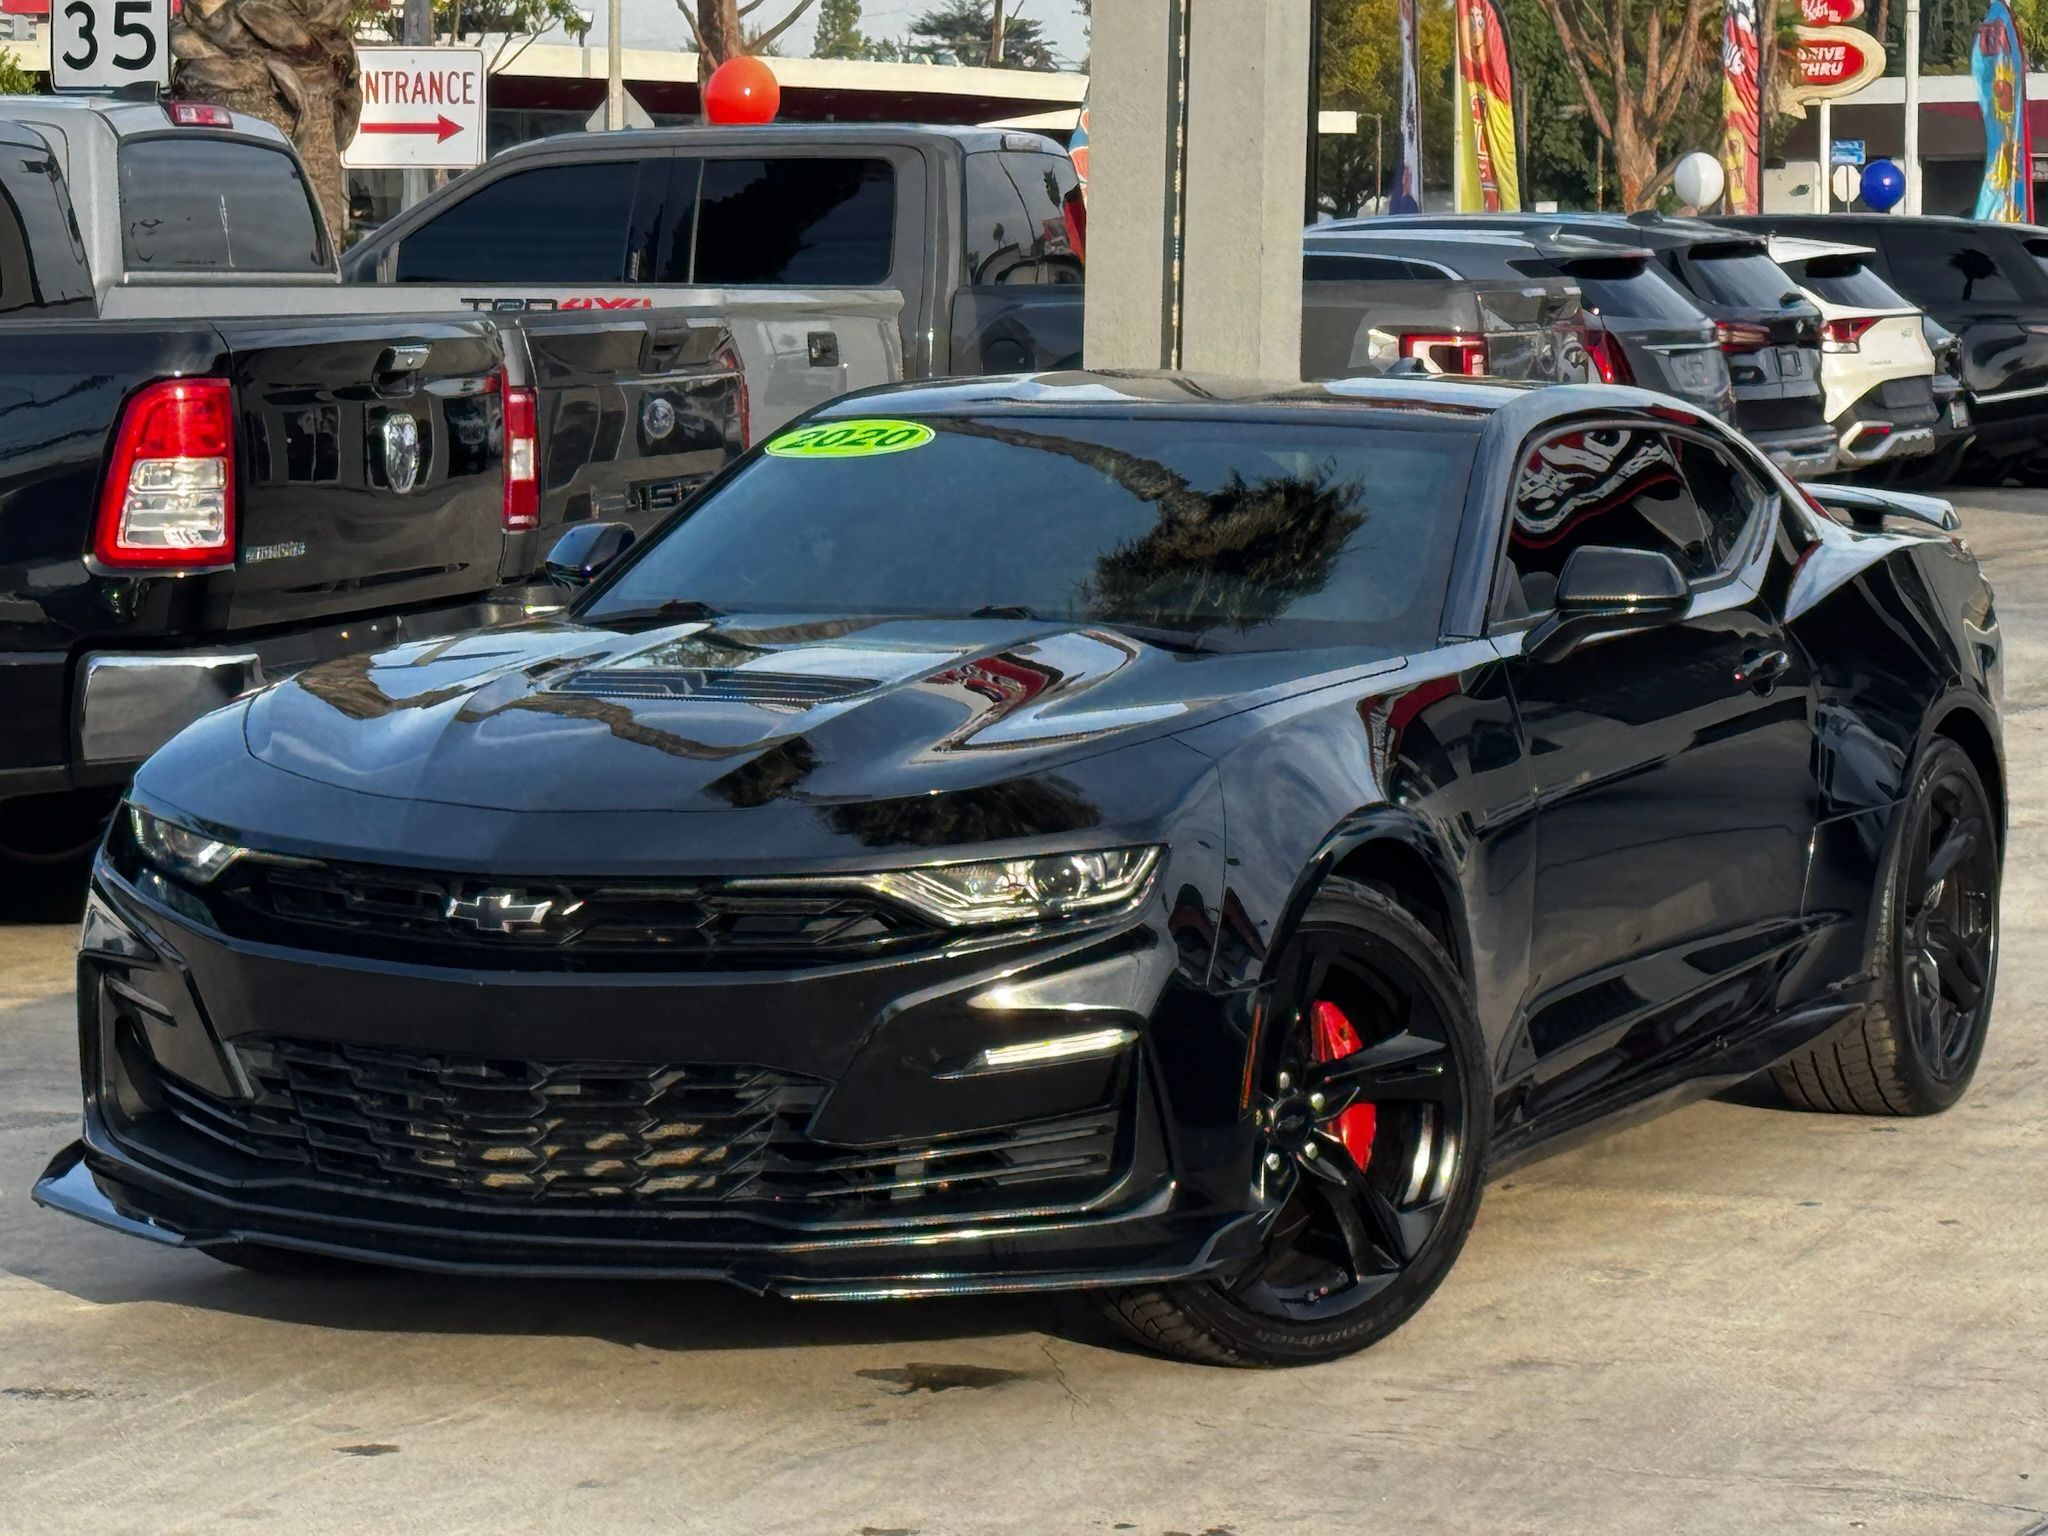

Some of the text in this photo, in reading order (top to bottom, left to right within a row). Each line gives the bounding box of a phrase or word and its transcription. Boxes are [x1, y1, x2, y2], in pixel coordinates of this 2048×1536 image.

[62, 1, 157, 71] 35
[363, 70, 476, 105] NTRANCE
[777, 428, 920, 451] 2020
